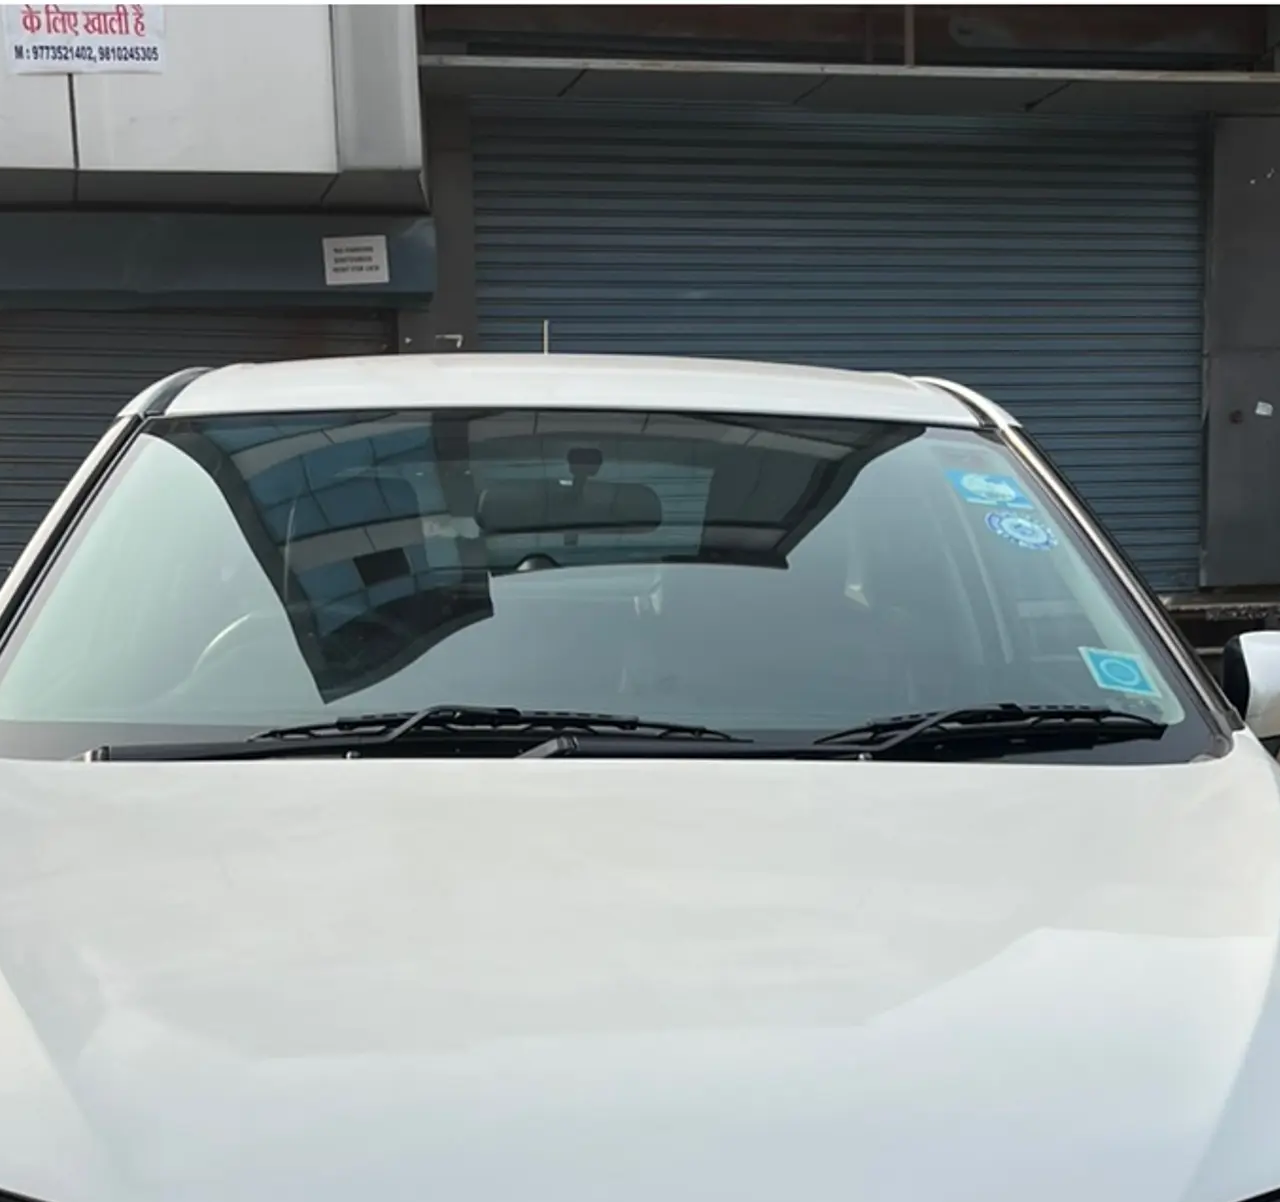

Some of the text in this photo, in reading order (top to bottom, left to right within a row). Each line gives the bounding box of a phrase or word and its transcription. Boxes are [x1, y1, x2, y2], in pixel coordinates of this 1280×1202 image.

[21, 4, 42, 34] के
[44, 4, 79, 36] लिए
[82, 4, 130, 35] खाली
